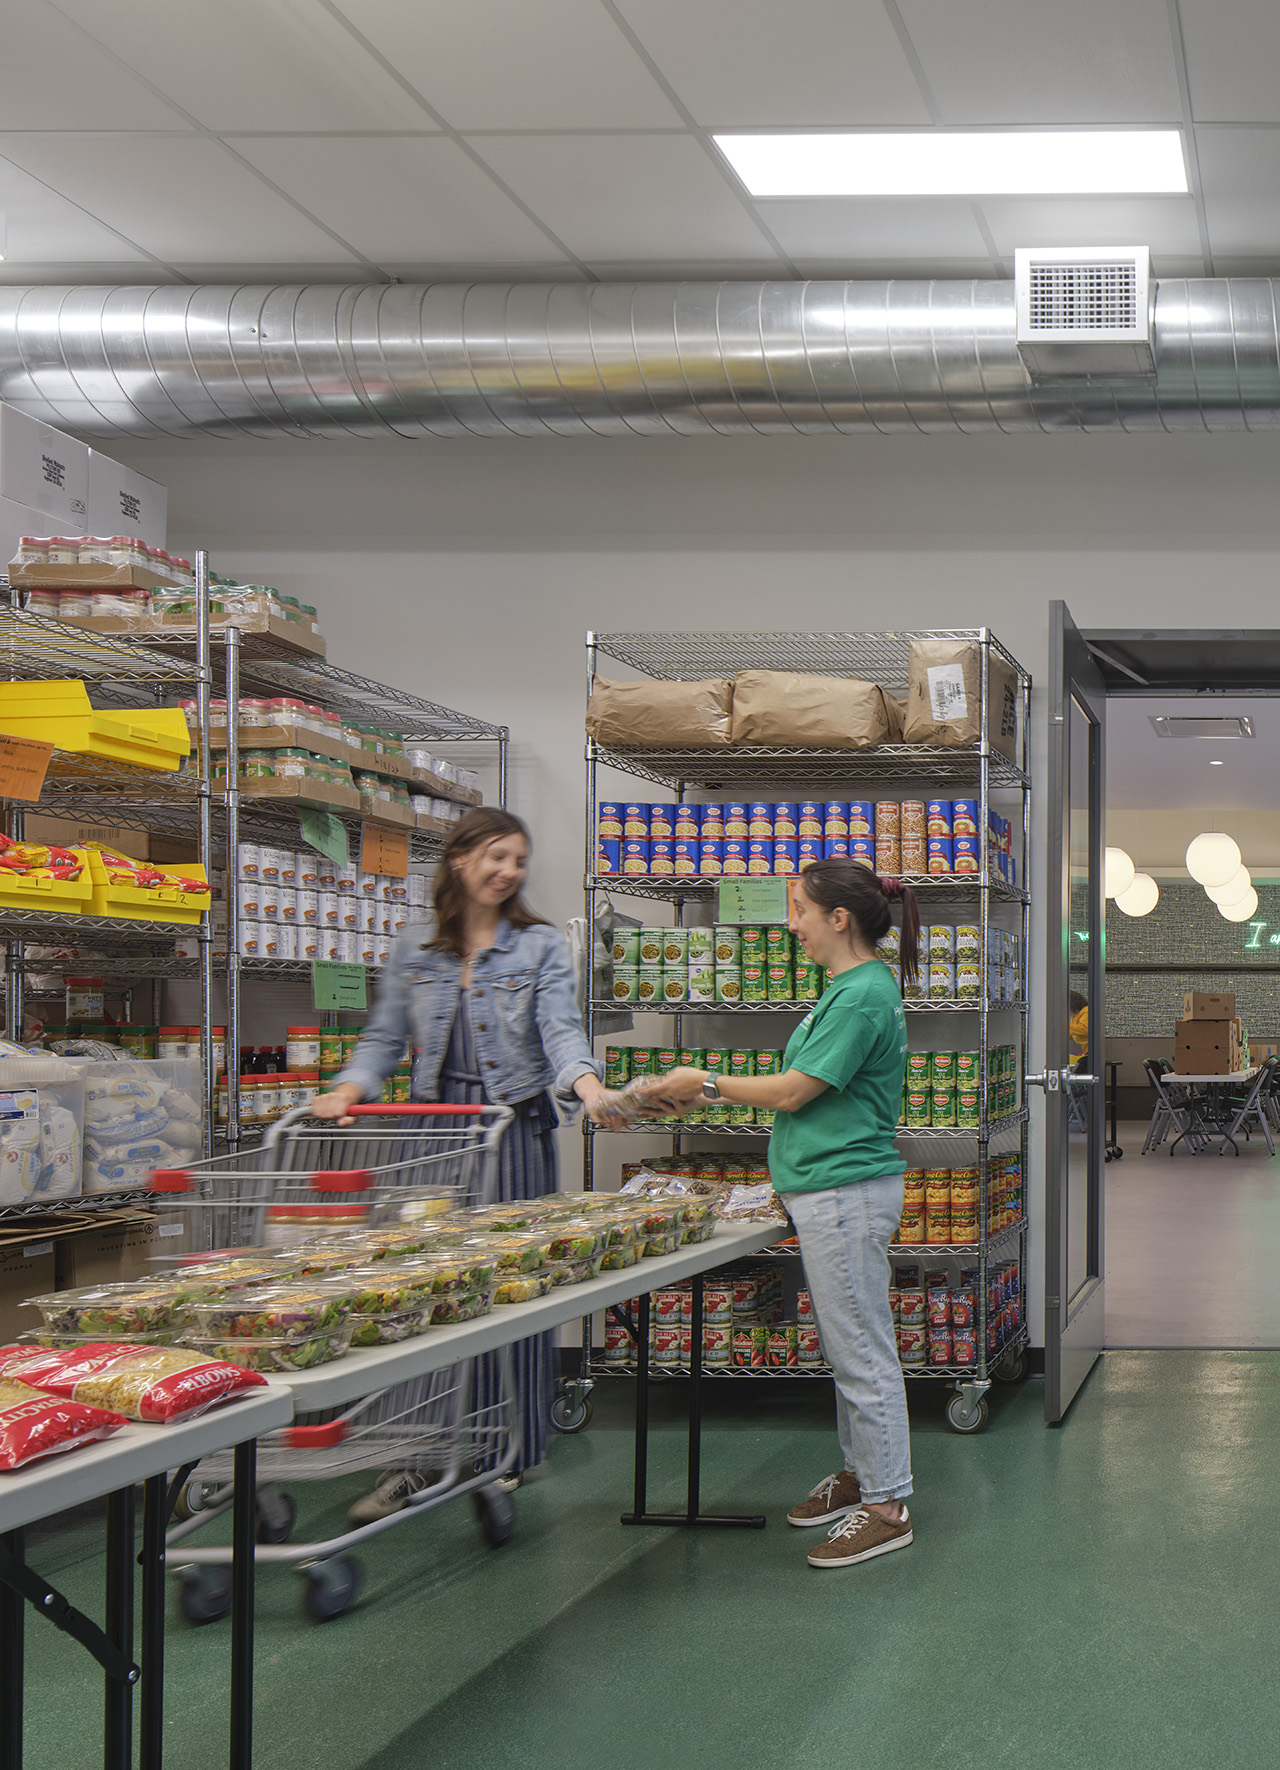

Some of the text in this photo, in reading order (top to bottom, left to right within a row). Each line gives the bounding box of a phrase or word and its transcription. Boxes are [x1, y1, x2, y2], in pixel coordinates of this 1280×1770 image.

[180, 894, 188, 905] 2
[1245, 922, 1267, 948] I
[98, 1241, 136, 1254] INVESTING
[3, 1263, 34, 1273] PEOPLE
[180, 1366, 241, 1392] ELBOWS
